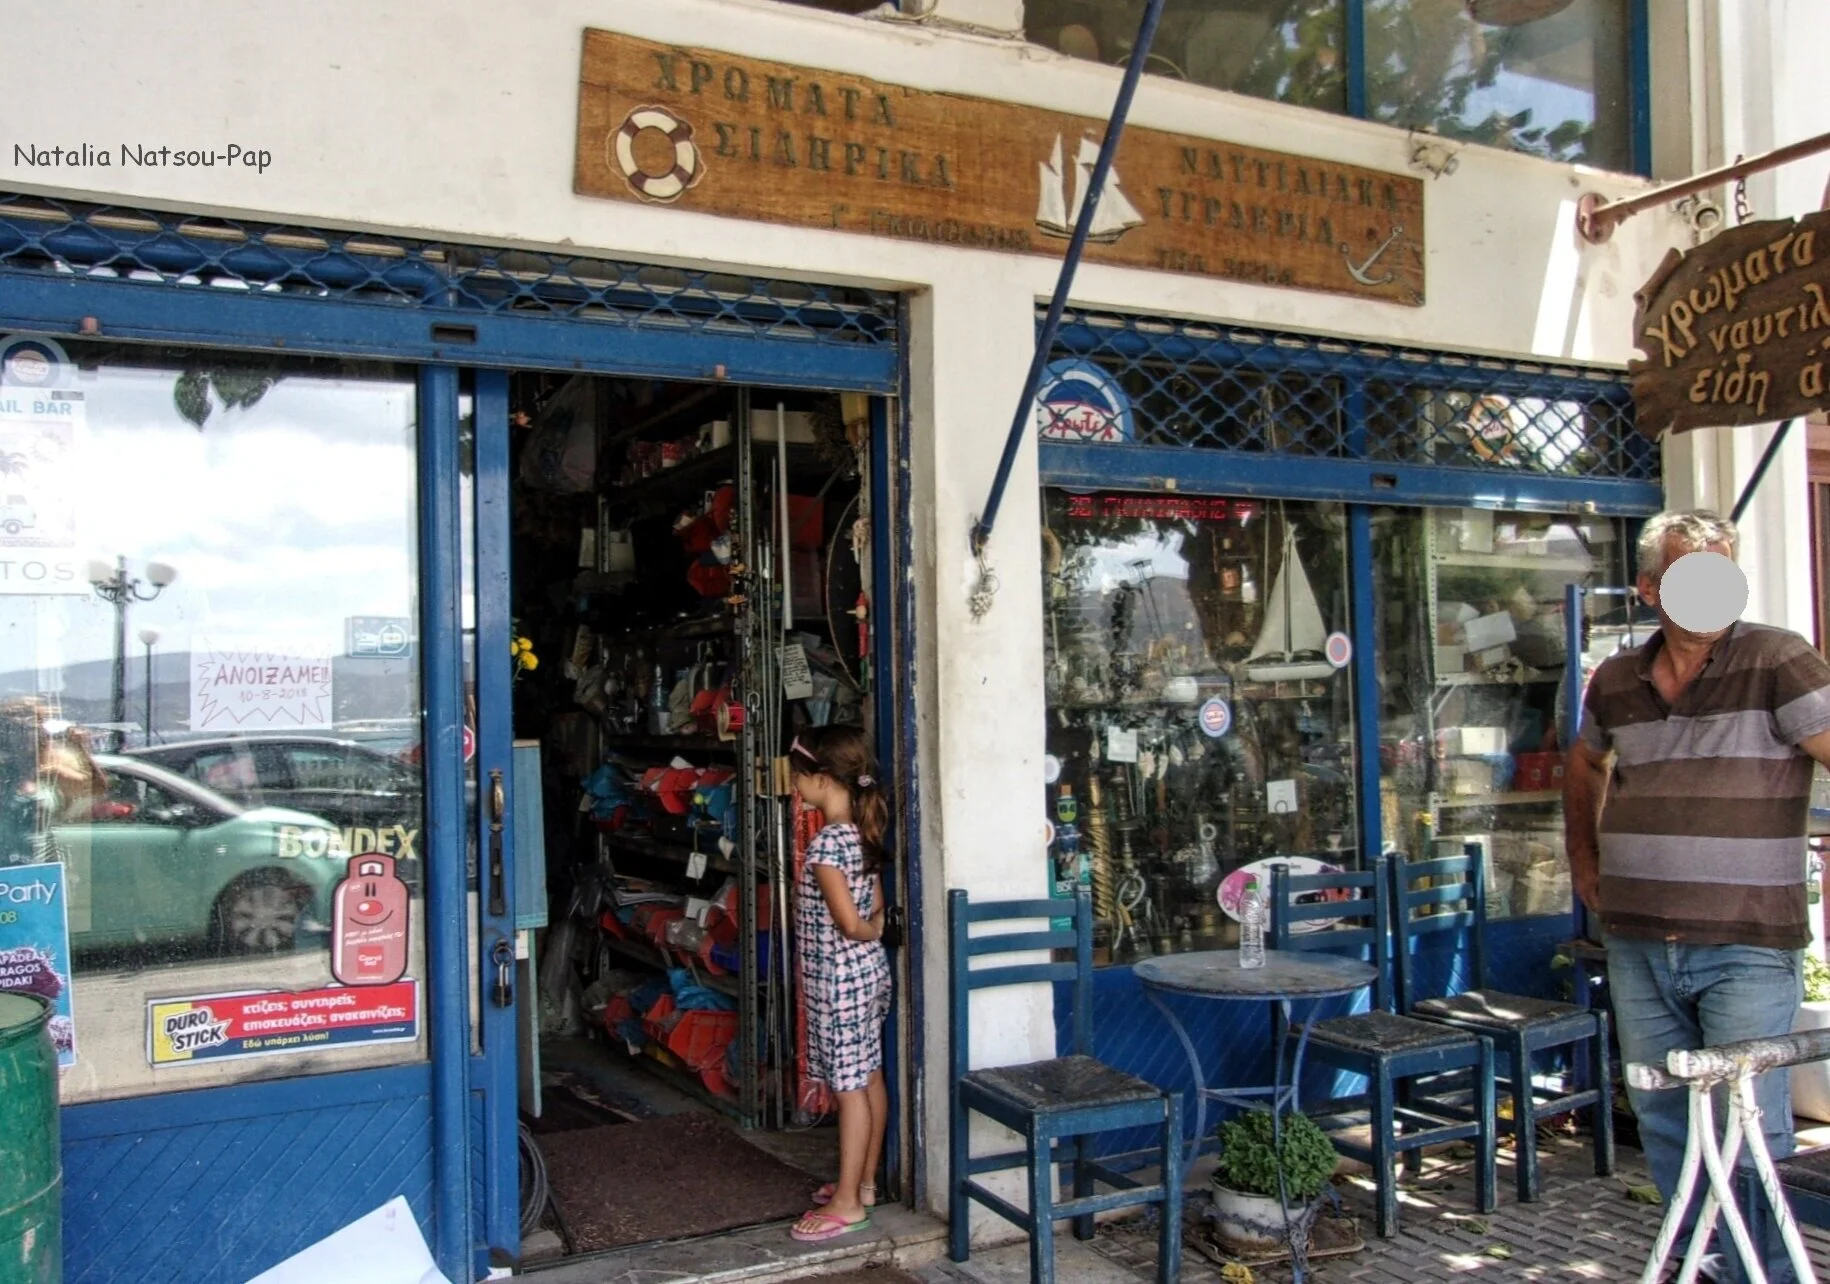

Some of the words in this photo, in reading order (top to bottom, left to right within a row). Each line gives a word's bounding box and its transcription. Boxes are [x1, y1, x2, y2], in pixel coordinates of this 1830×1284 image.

[651, 51, 896, 128] ΧΡΩΜΑΤΑ
[713, 121, 956, 190] ΣΙΔΗΡΙΚΑ
[1800, 336, 1830, 398] ά
[33, 401, 73, 415] BAR
[278, 824, 418, 860] BONDEX
[0, 879, 57, 905] Party
[0, 975, 33, 988] IDAKI
[166, 1010, 208, 1033] DURO
[175, 1026, 223, 1050] STICK
